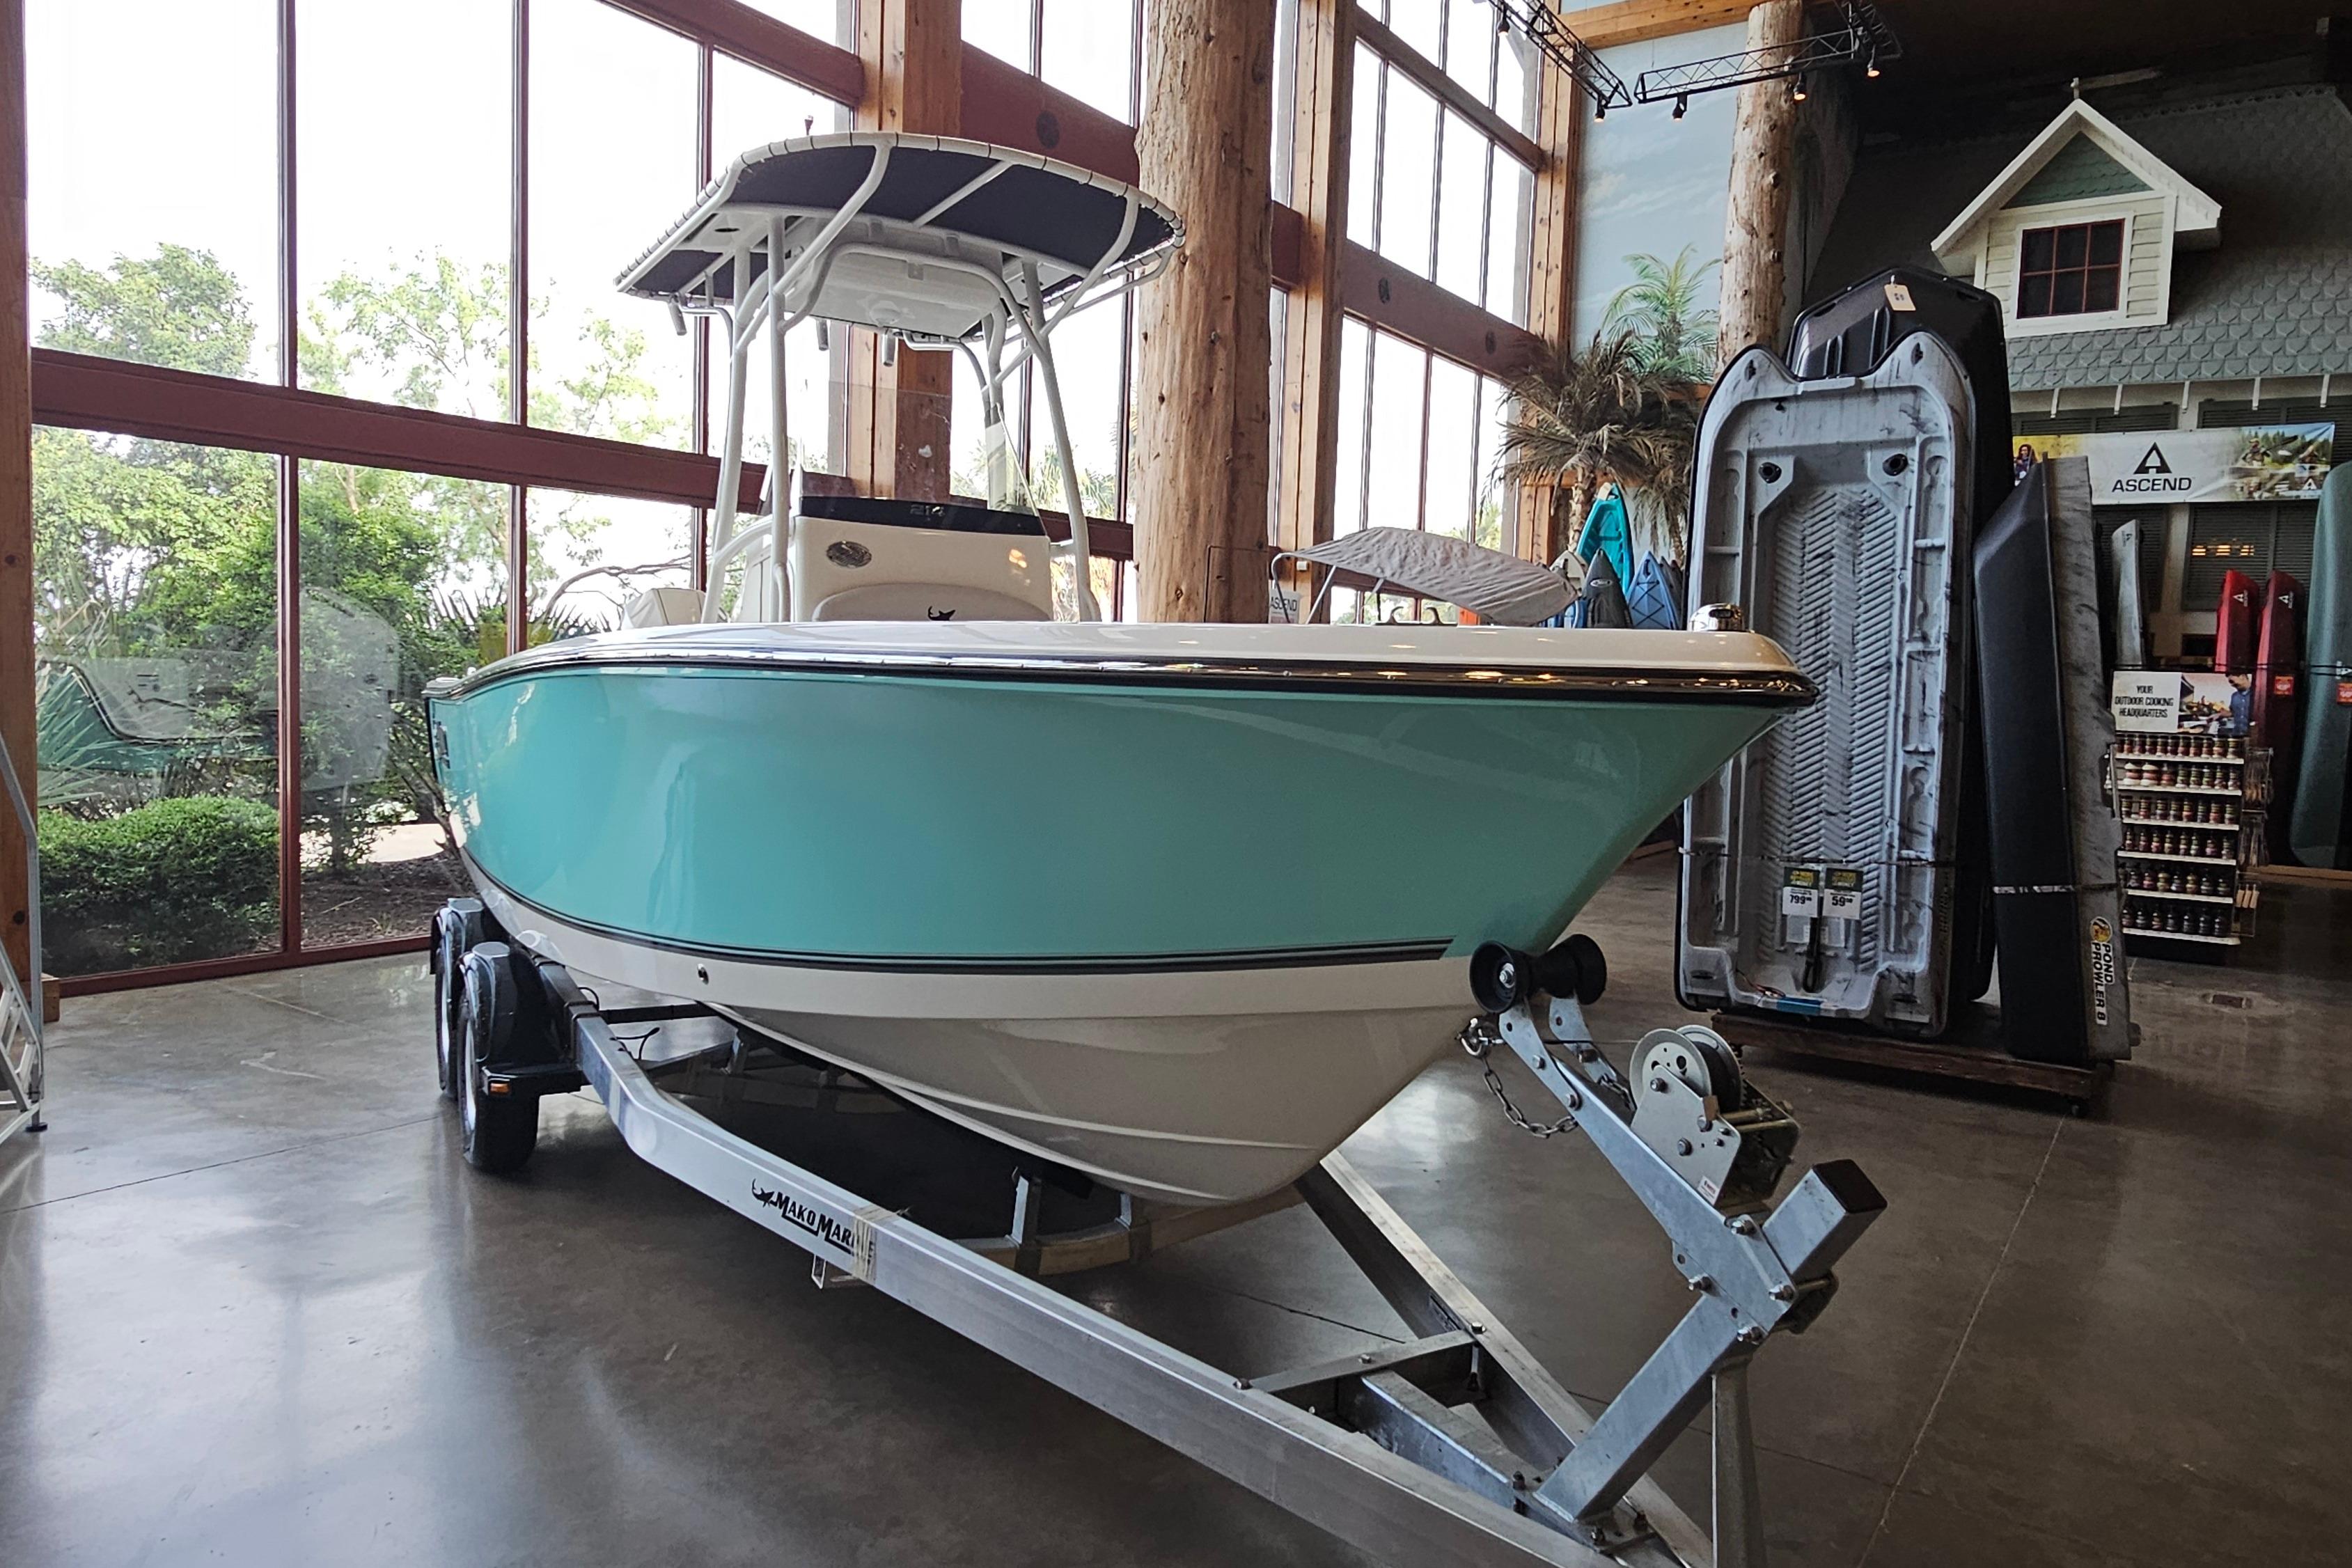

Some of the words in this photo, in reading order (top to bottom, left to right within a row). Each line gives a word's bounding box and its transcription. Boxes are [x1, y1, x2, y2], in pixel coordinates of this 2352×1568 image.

[2111, 477, 2192, 492] ASCEND
[2136, 685, 2154, 694] YOUR
[2115, 696, 2144, 705] OUTDOOR
[2145, 697, 2174, 707] COOKING
[2119, 707, 2168, 719] HEADQUARTERS
[2102, 943, 2114, 984] POND
[2092, 942, 2106, 1008] PROWLER
[2096, 1012, 2106, 1021] 8
[771, 1191, 818, 1231] MAKO
[817, 1213, 875, 1253] MARIE
